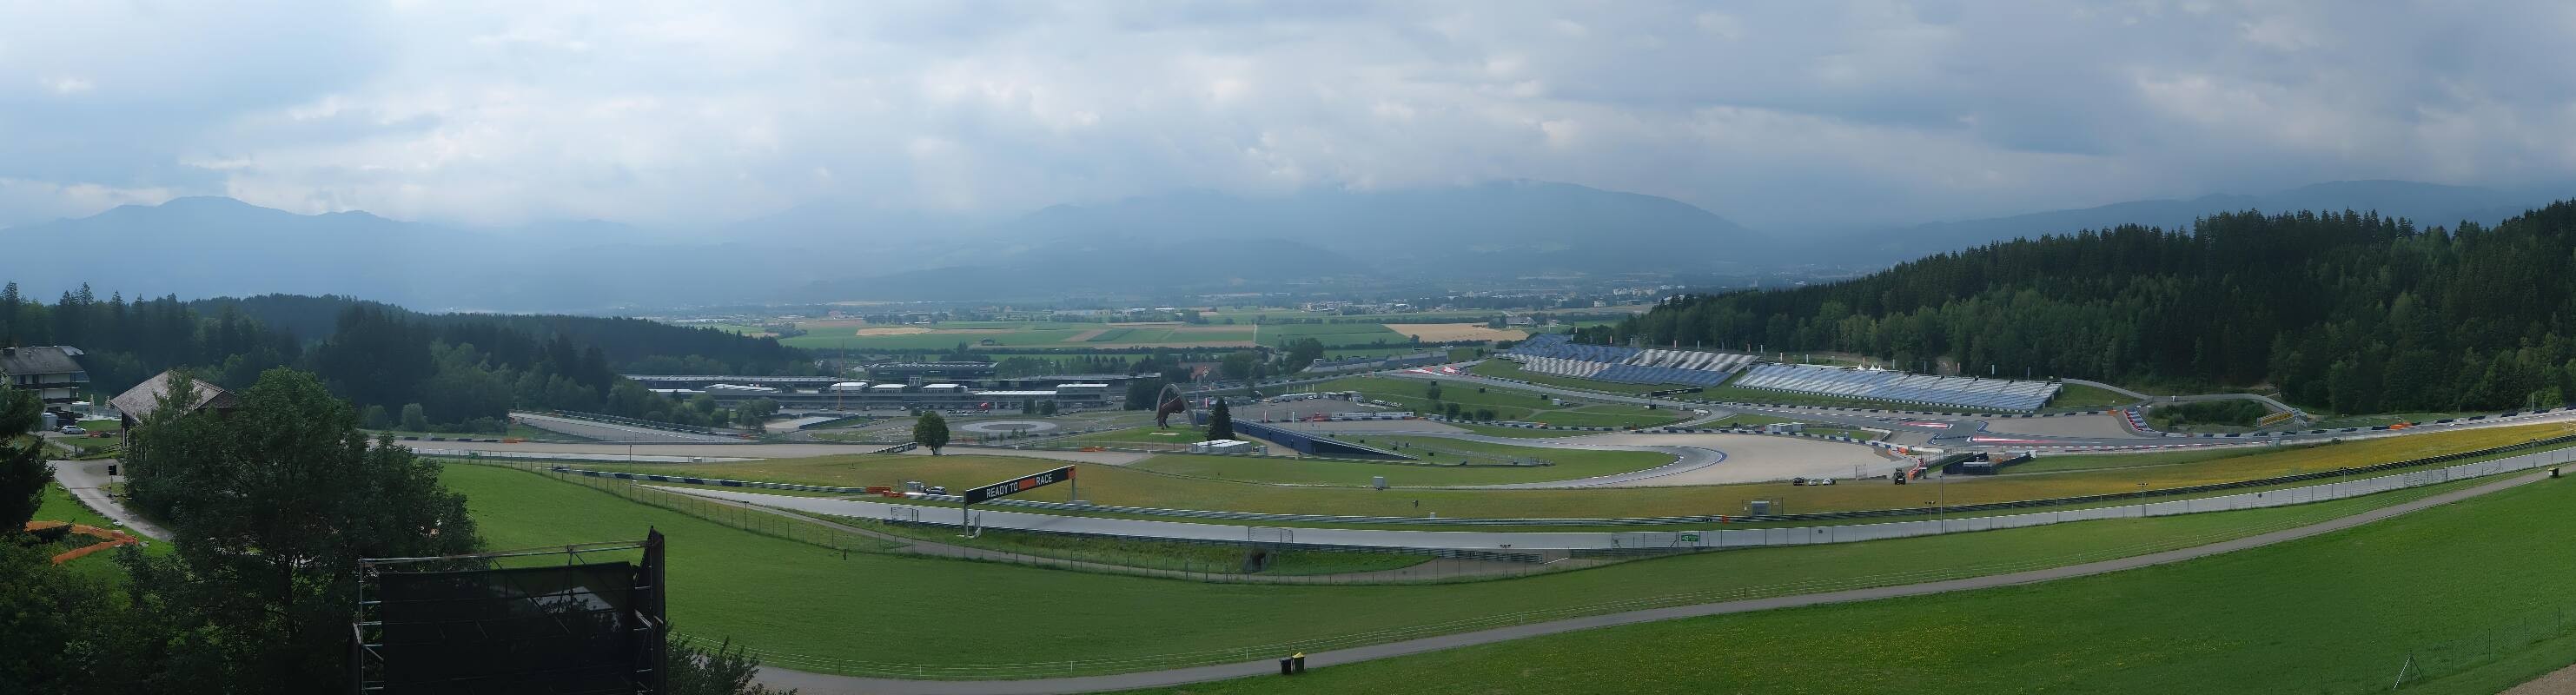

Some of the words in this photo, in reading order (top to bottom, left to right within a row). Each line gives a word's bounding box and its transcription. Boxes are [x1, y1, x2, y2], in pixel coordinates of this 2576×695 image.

[986, 484, 1008, 498] READY
[1010, 482, 1018, 492] TO
[1036, 473, 1052, 486] RACE
